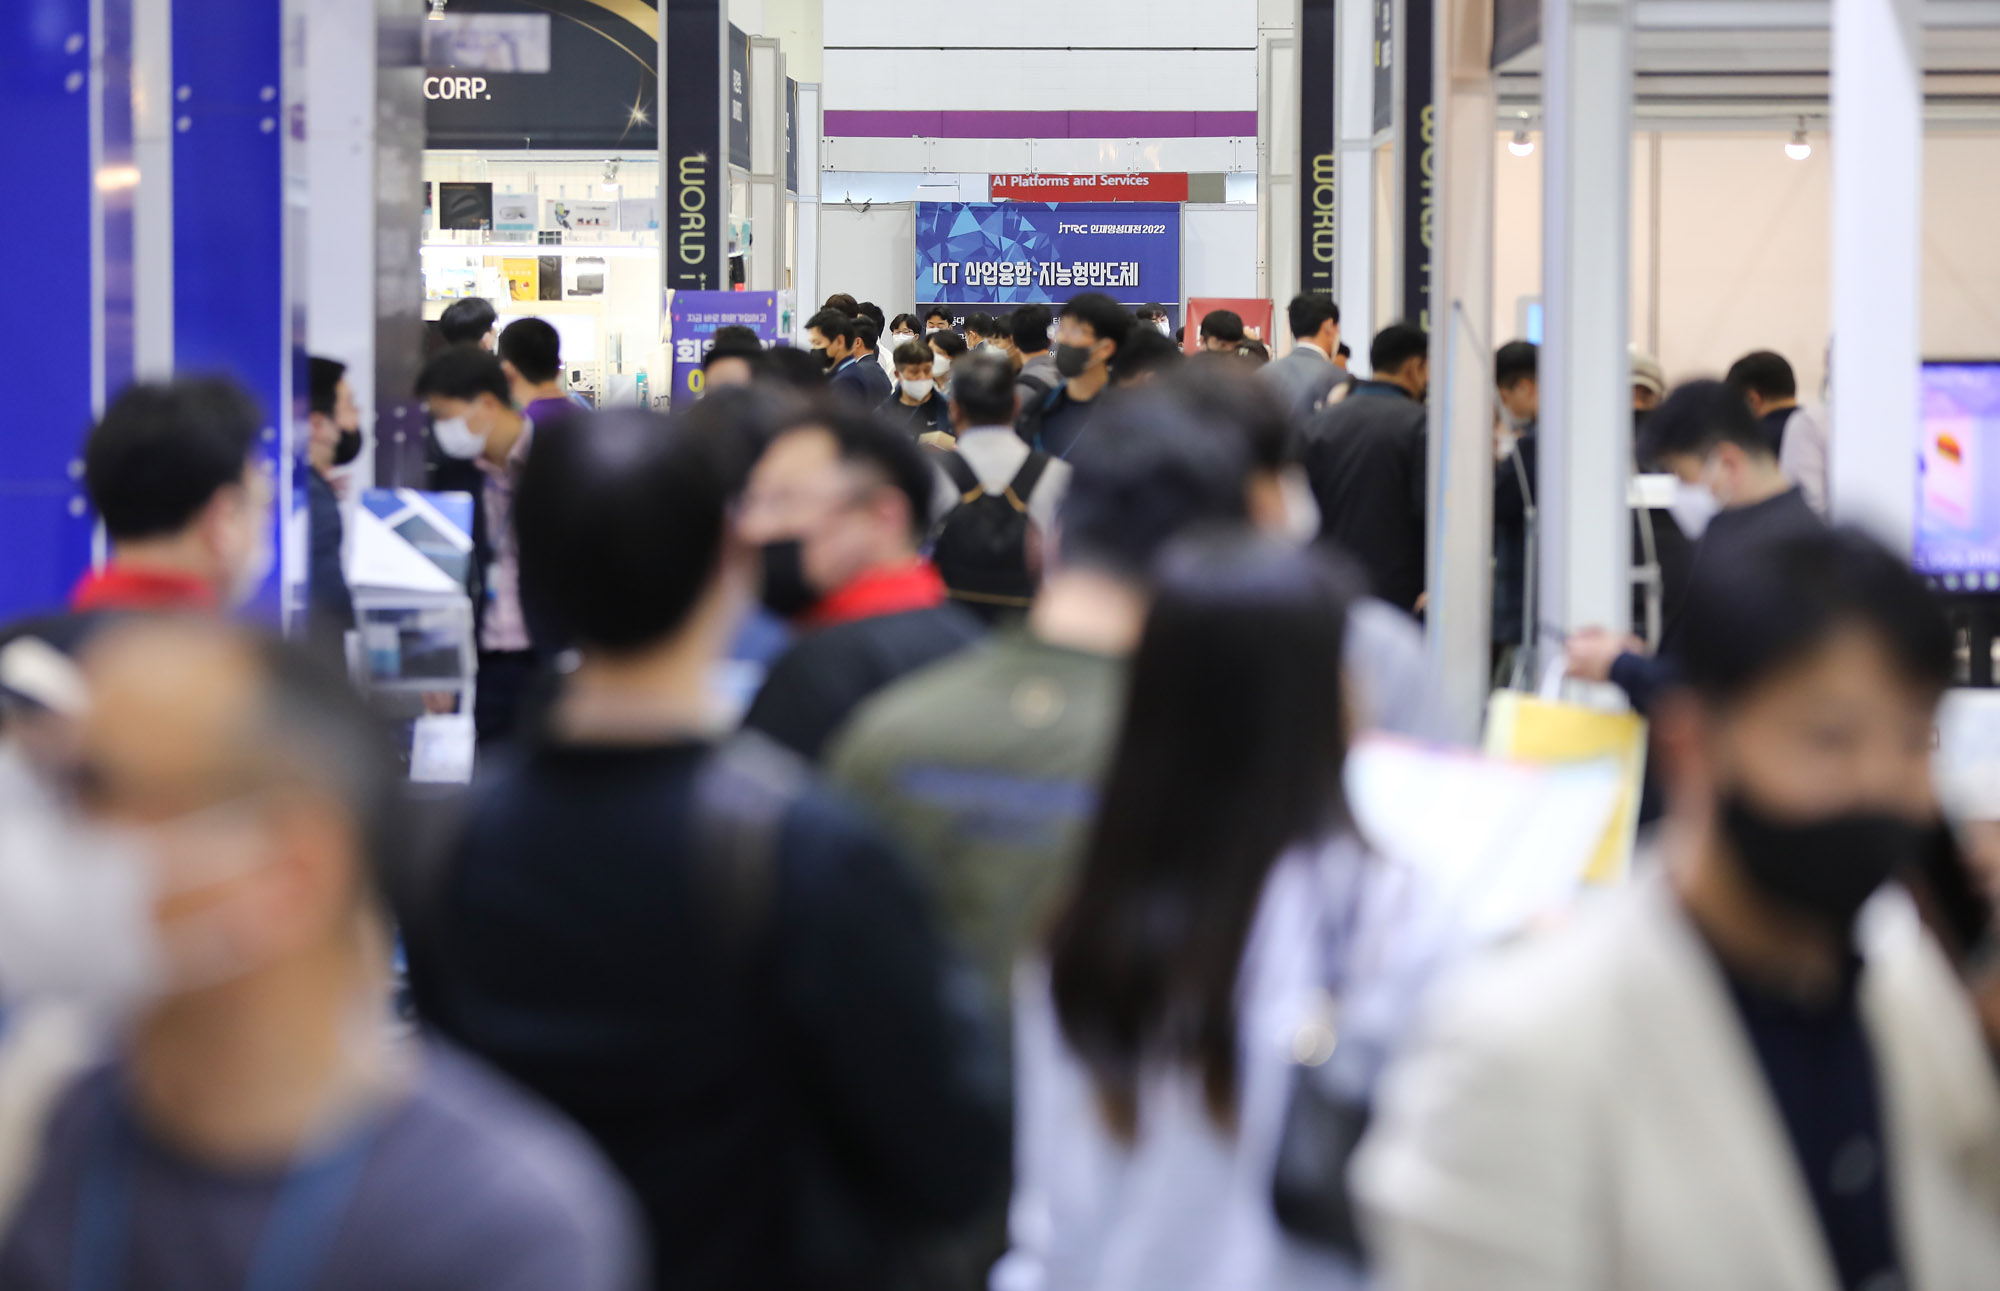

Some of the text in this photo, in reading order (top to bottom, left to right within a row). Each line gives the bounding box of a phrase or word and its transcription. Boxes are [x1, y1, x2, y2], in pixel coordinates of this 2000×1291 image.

[423, 76, 492, 100] CORP.
[993, 174, 1149, 187] AI Platforms and Services
[680, 156, 706, 264] WORLD
[932, 262, 960, 285] ICT
